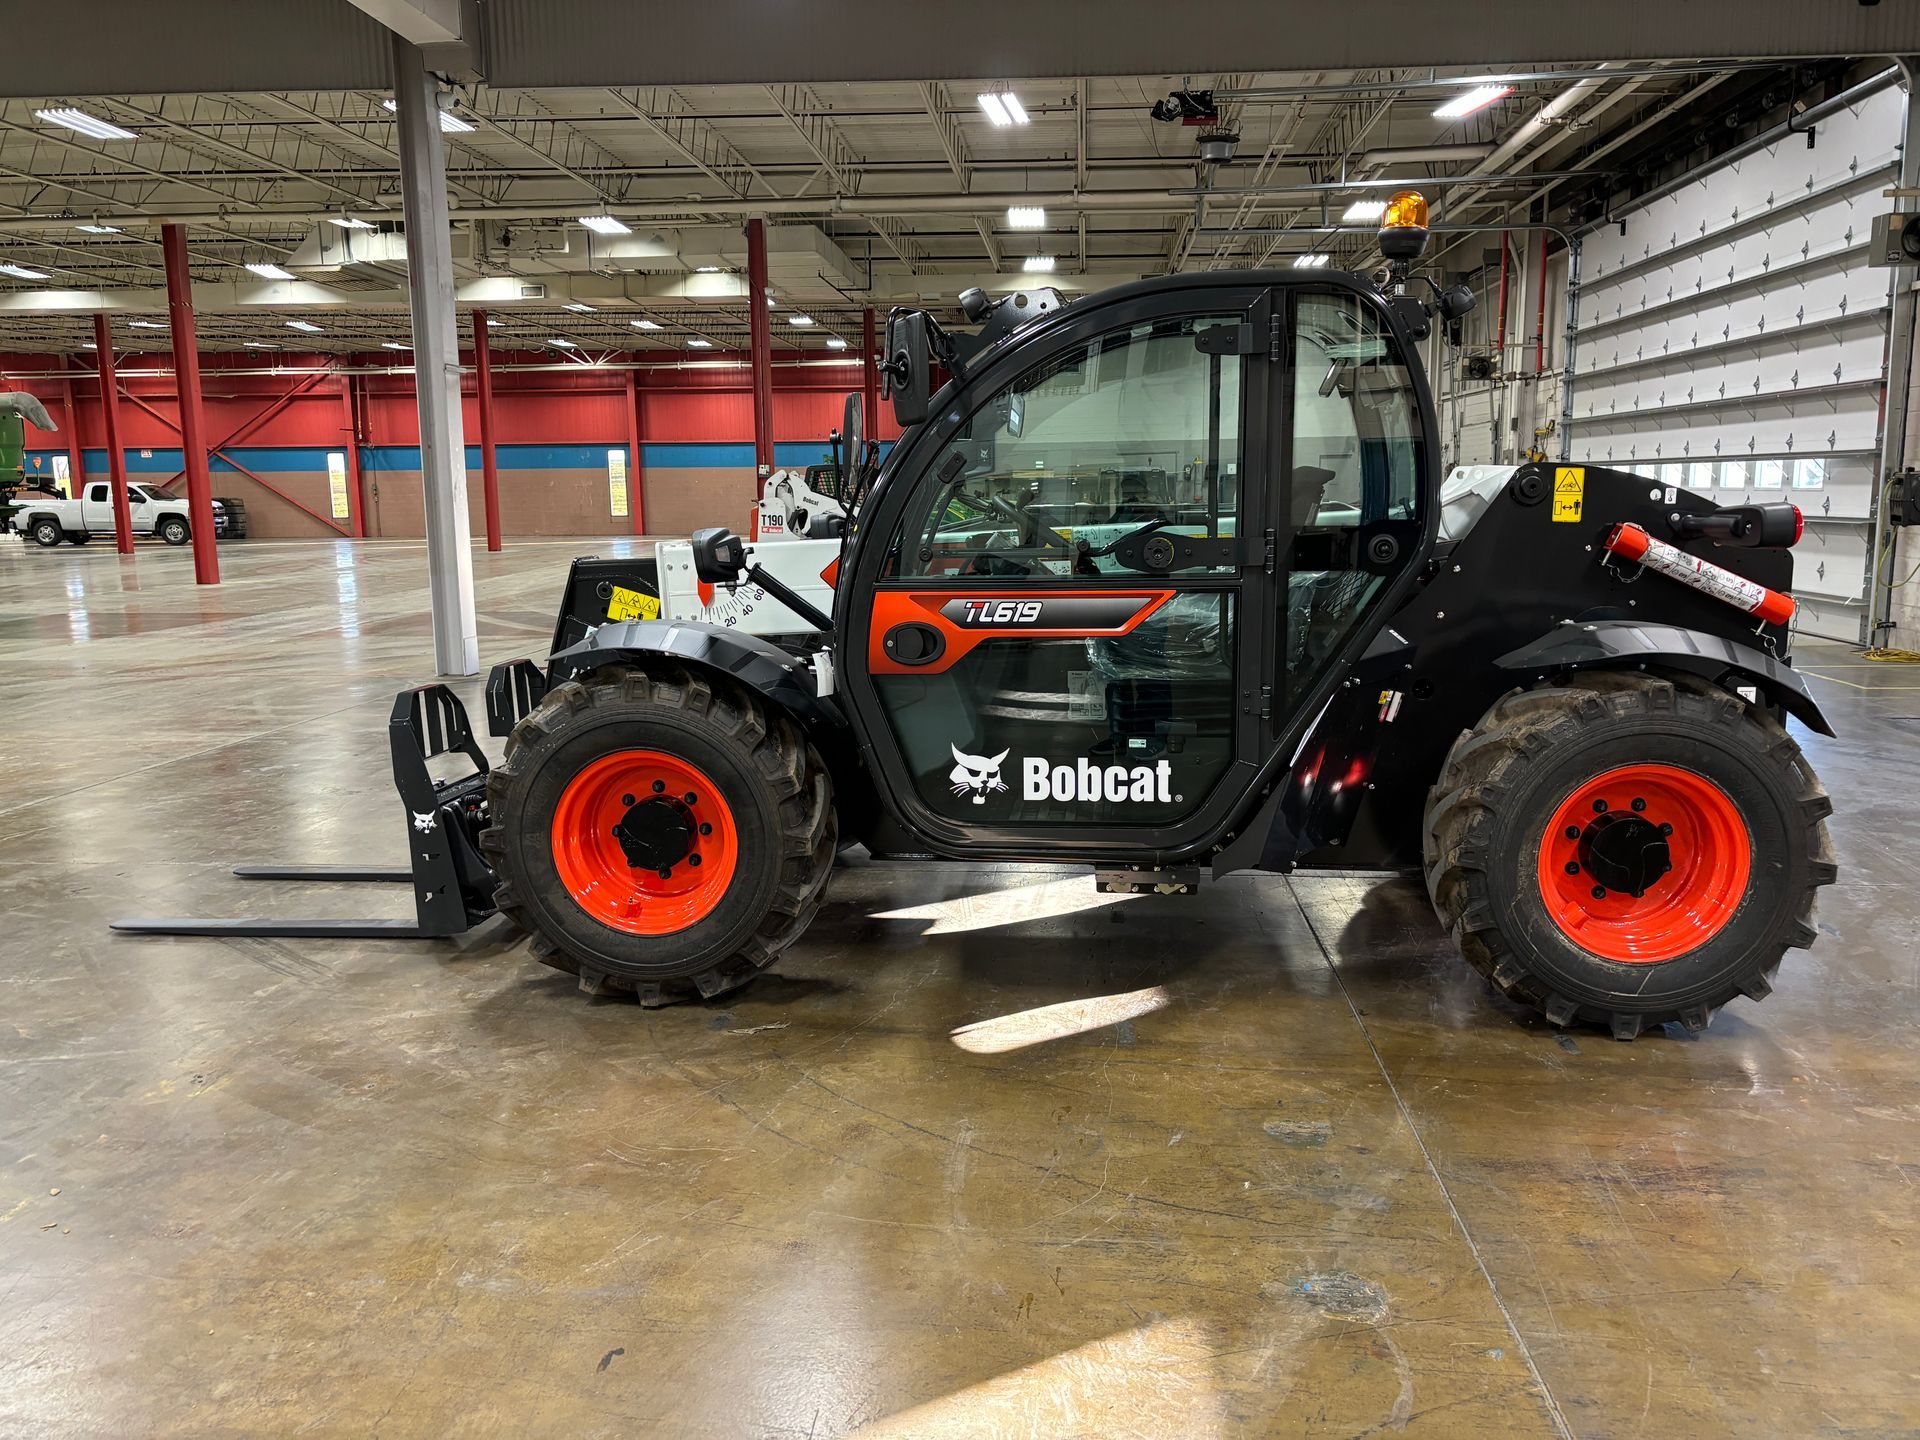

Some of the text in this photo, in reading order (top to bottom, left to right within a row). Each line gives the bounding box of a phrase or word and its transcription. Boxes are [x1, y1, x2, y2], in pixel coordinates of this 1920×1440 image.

[761, 515, 783, 526] T190
[754, 588, 765, 601] 60
[742, 604, 754, 616] 40
[965, 601, 1043, 623] TL619
[724, 616, 737, 627] 20
[1023, 757, 1172, 803] Bobcat
